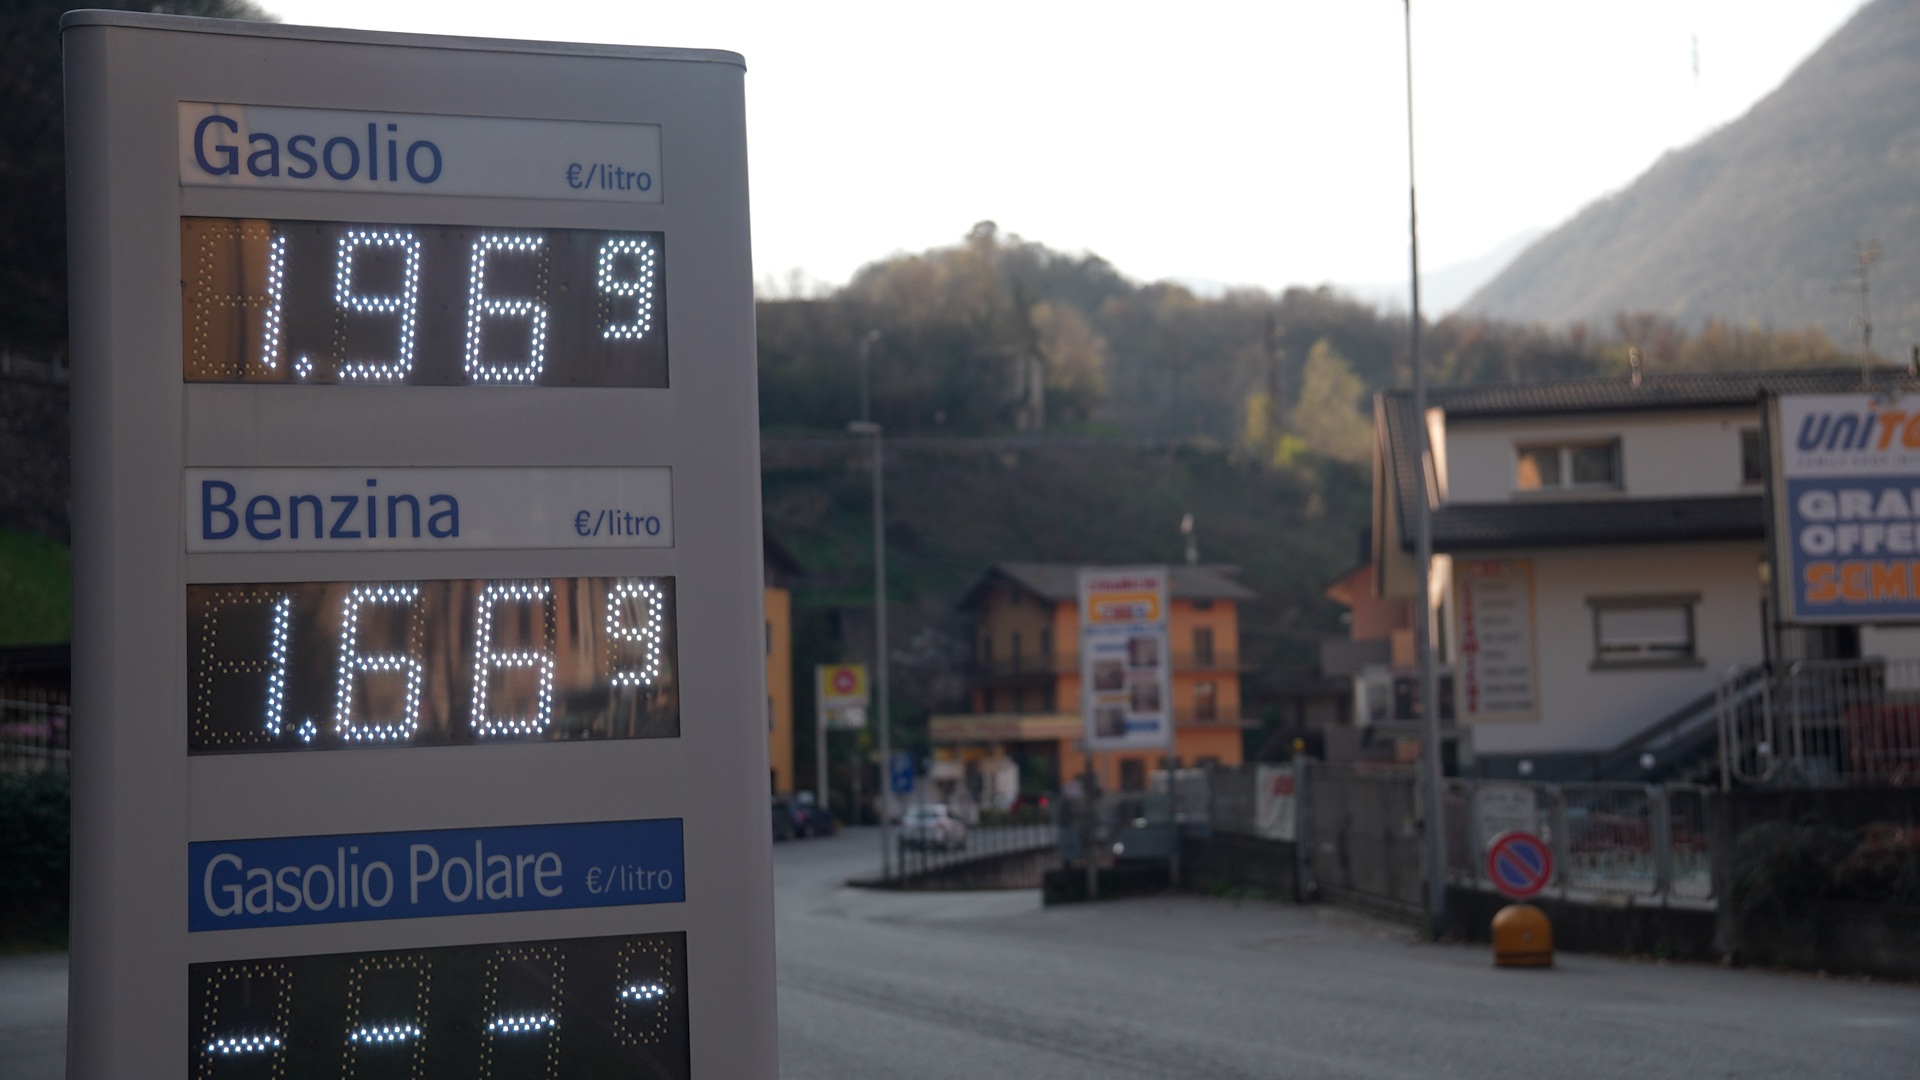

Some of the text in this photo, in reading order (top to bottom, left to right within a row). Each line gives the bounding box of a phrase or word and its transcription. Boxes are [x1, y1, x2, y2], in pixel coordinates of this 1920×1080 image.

[194, 115, 652, 192] Gasolio €/litro
[202, 479, 661, 540] Benzina €/litro
[1800, 524, 1920, 555] OFFE
[1804, 561, 1920, 603] SEM
[203, 840, 673, 917] Gasolio Polare €/litro
